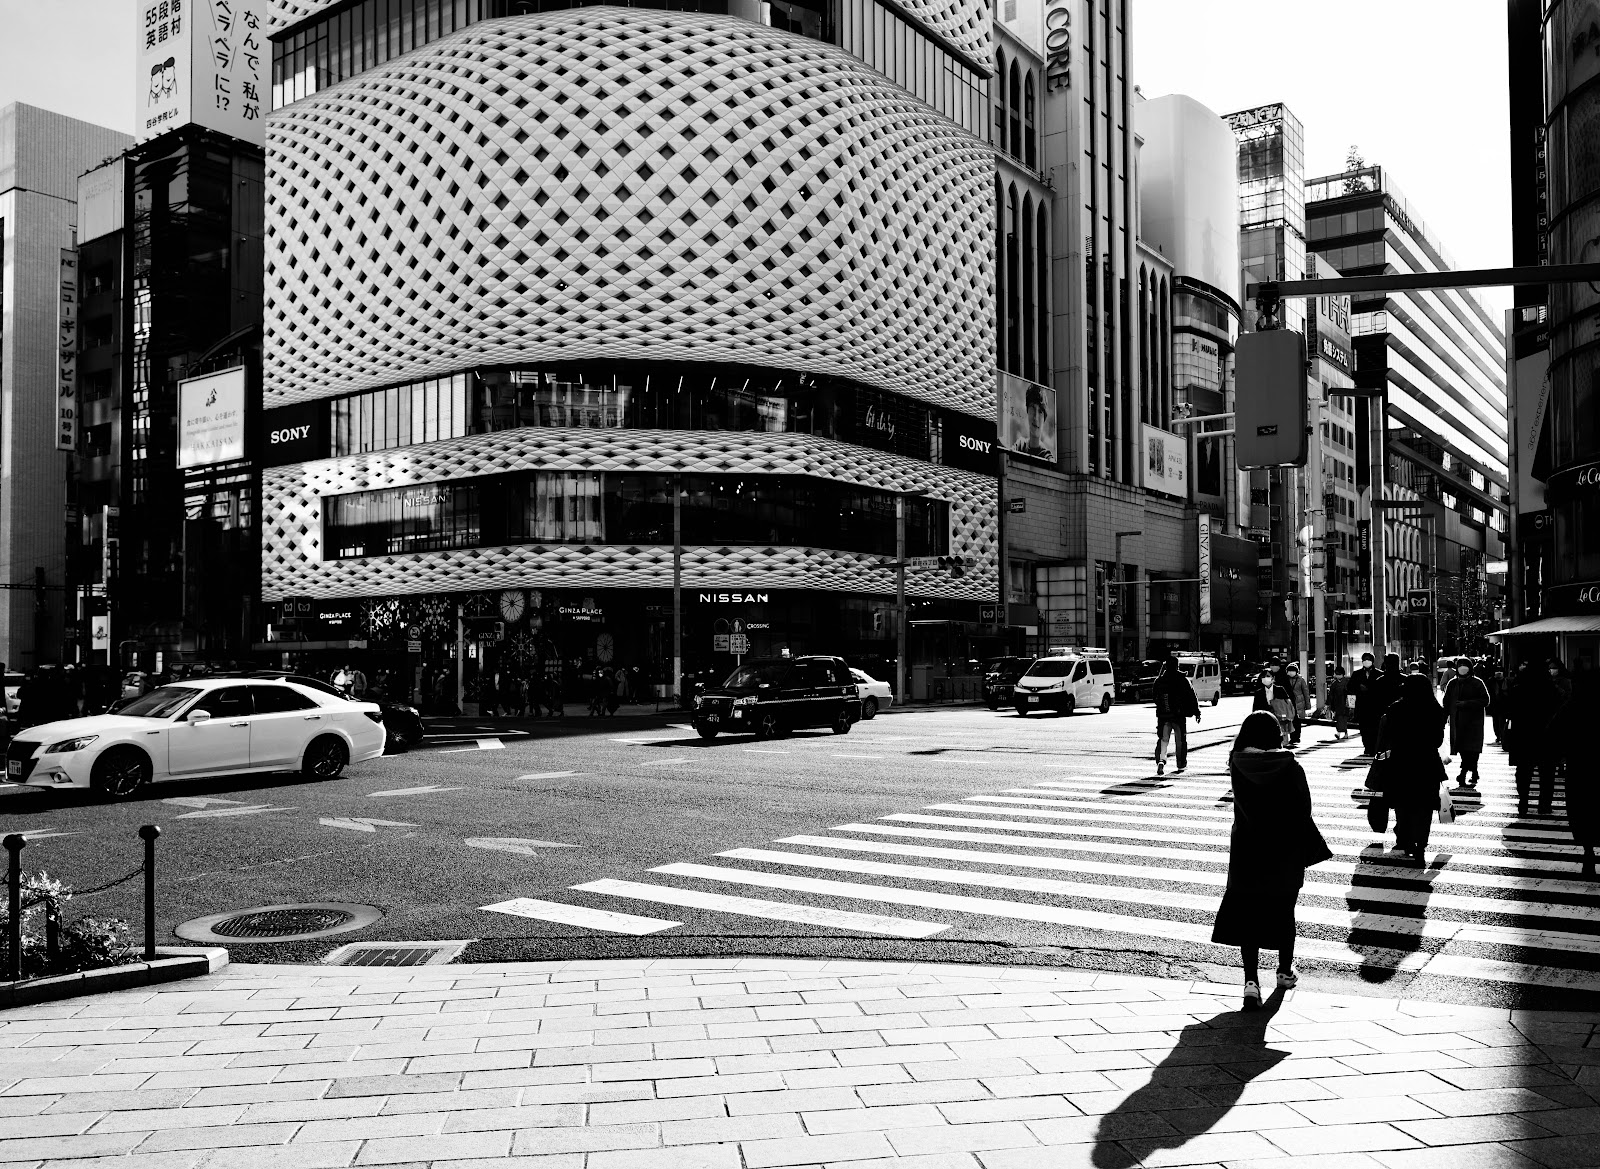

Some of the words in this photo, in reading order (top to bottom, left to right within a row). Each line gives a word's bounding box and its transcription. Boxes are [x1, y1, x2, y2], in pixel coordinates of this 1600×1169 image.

[145, 15, 181, 50] 英語村
[1046, 7, 1070, 93] CORE
[243, 10, 260, 121] なんで、私が
[1539, 171, 1546, 180] 5
[1540, 217, 1547, 226] 3
[60, 280, 76, 398] ニューギンザビル
[1537, 331, 1549, 342] RIC
[271, 425, 310, 444] SONY
[959, 434, 991, 454] SONY
[404, 495, 445, 508] NISSAN
[1200, 500, 1219, 511] PRADA
[1200, 523, 1209, 560] GINZA
[699, 593, 769, 603] NISSAN
[559, 606, 580, 614] GINZA
[581, 607, 603, 615] PLACE
